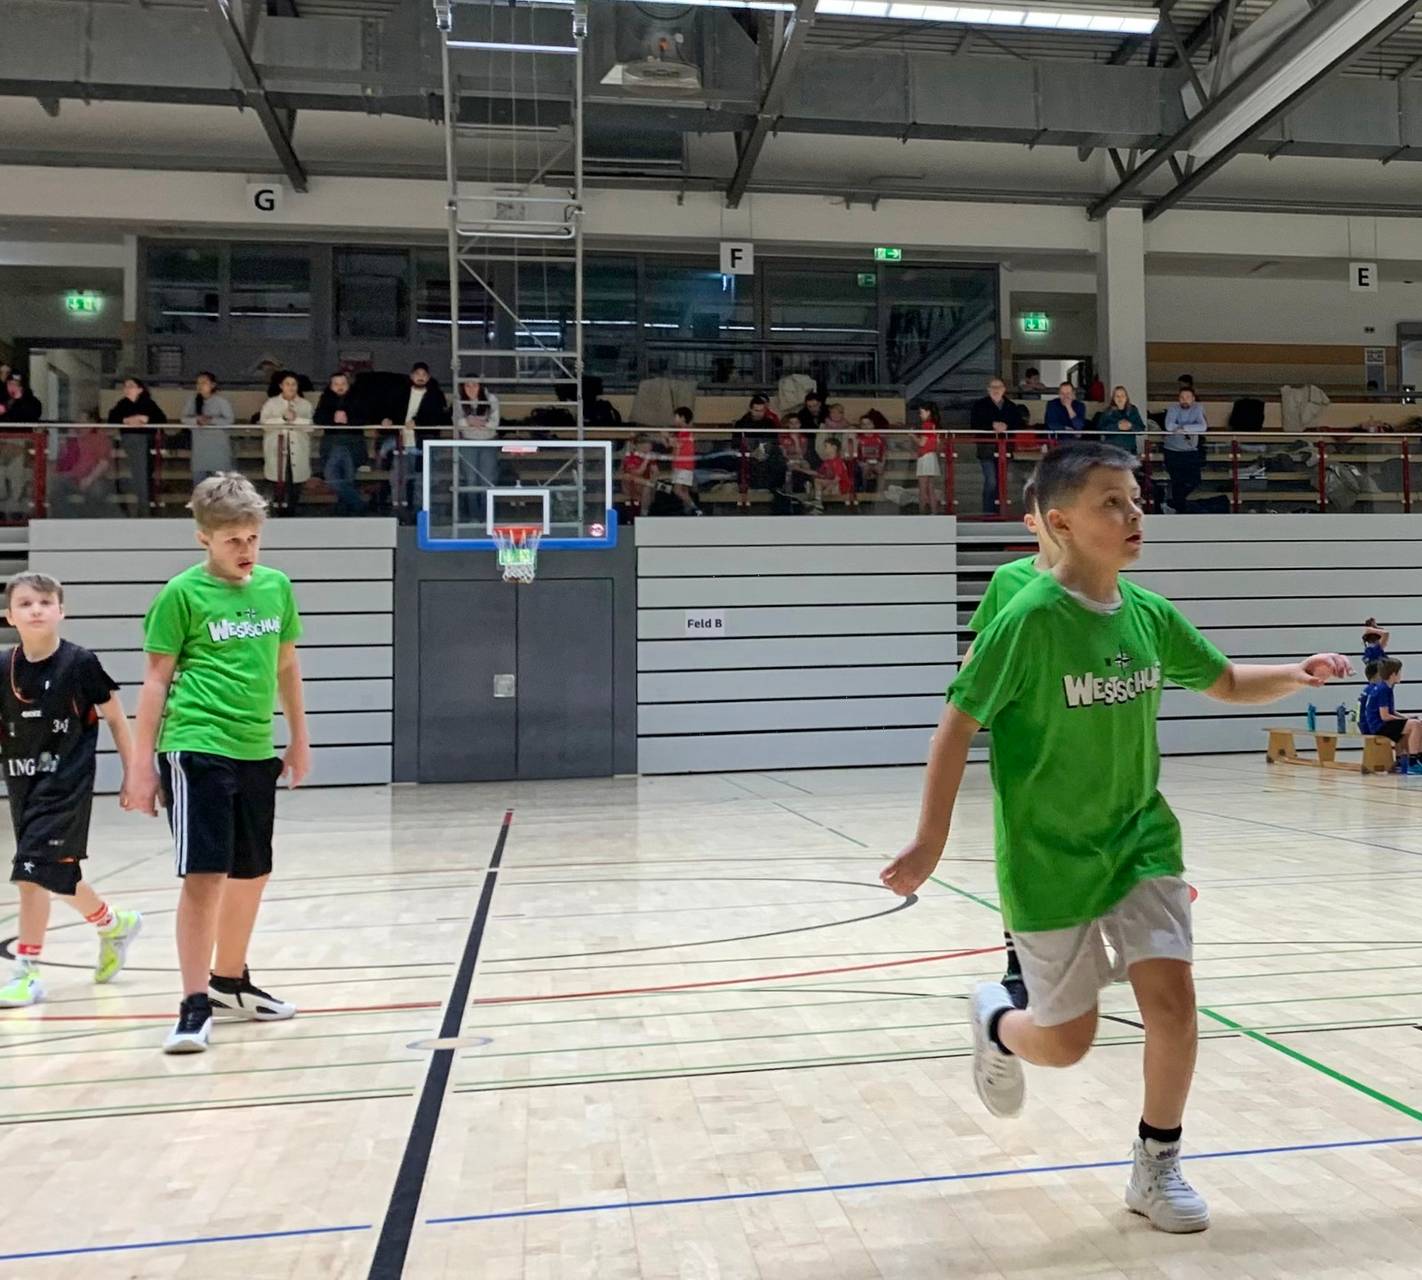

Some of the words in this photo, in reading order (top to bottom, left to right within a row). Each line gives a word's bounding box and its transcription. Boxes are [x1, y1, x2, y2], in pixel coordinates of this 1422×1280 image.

[254, 189, 275, 211] G
[730, 247, 743, 269] F
[1358, 267, 1370, 287] E
[687, 618, 712, 629] Feld
[715, 618, 722, 629] B
[8, 758, 36, 777] ING
